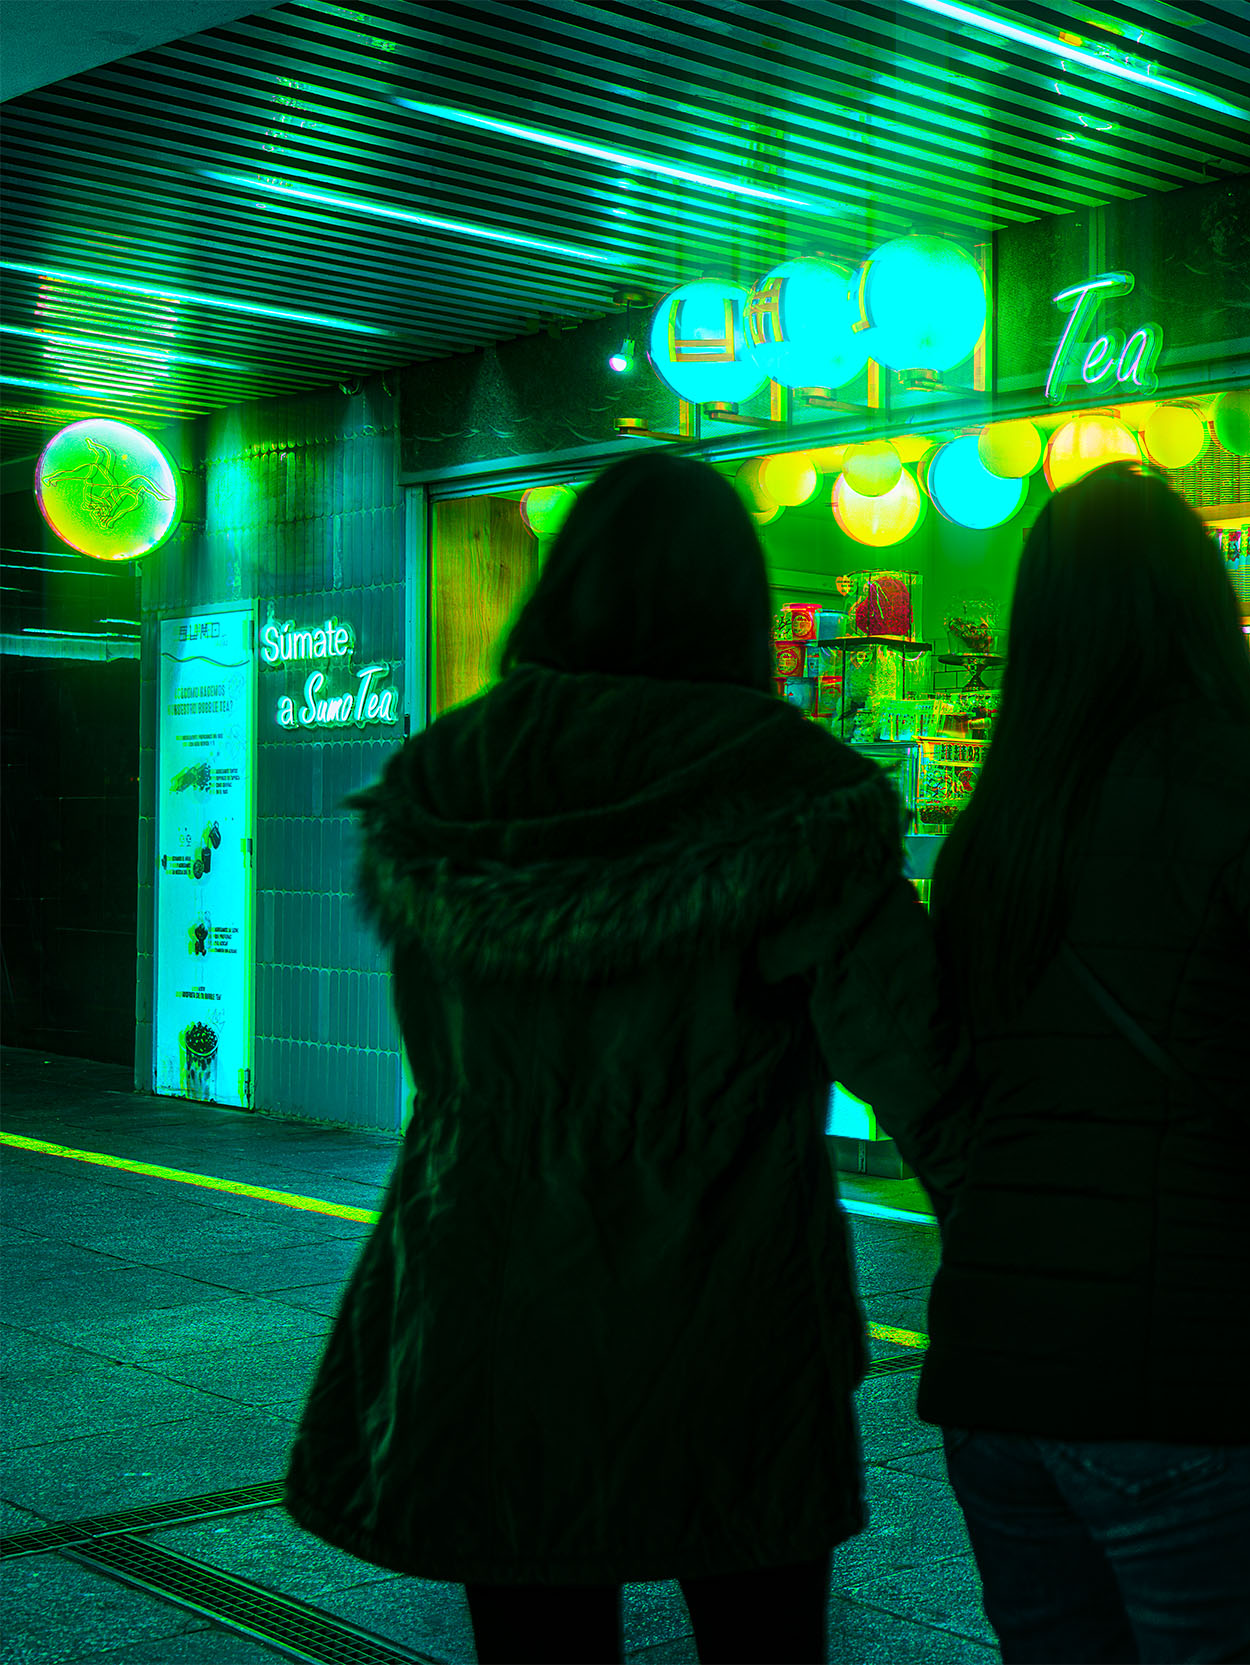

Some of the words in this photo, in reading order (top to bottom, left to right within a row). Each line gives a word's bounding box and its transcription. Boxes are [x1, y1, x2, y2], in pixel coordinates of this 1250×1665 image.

[1045, 272, 1158, 400] Tea
[262, 619, 350, 664] Súmate
[278, 696, 296, 726] a
[355, 665, 397, 723] Tea
